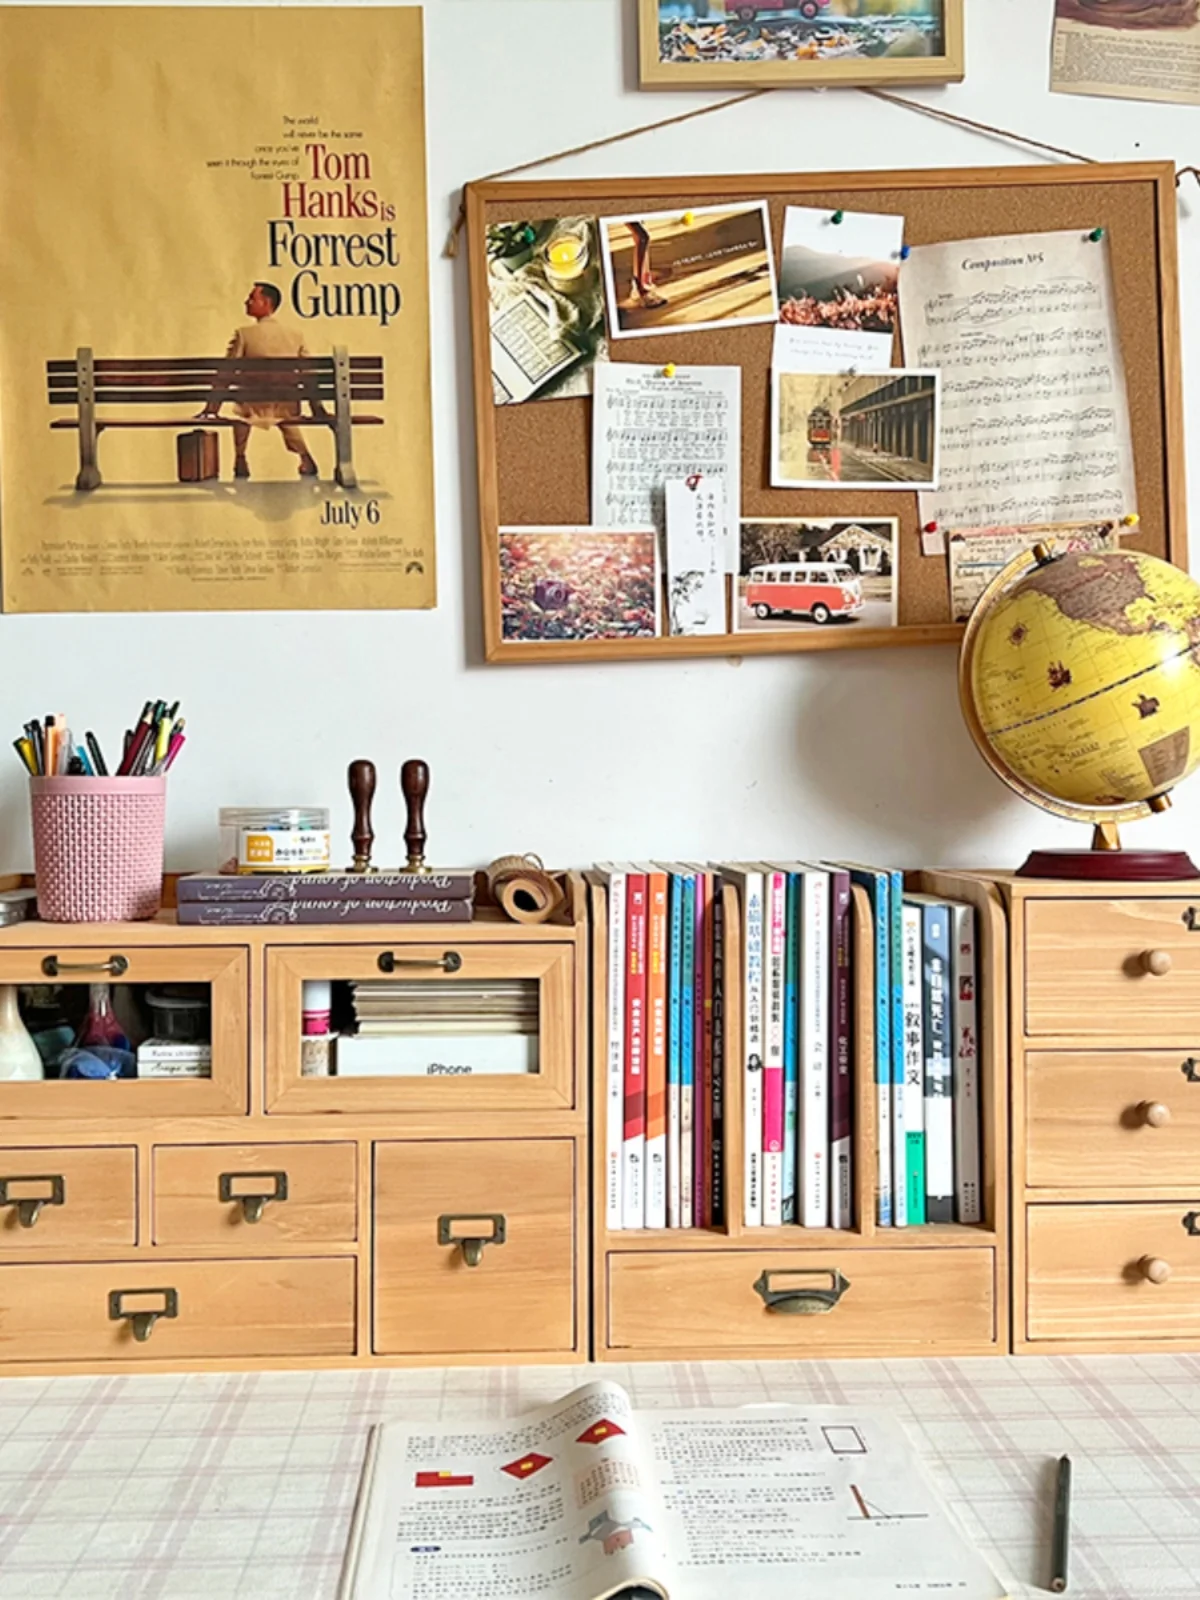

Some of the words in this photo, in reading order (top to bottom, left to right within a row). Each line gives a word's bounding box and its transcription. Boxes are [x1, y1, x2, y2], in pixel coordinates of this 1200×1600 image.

[283, 116, 296, 125] The
[299, 116, 318, 125] world
[283, 131, 295, 139] will
[298, 131, 316, 139] never
[319, 130, 329, 139] be
[331, 130, 342, 139] the
[344, 131, 363, 139] same
[254, 145, 273, 153] once
[231, 158, 257, 170] through
[259, 158, 270, 167] the
[272, 160, 290, 169] eyes
[291, 158, 299, 167] of
[305, 143, 371, 180] Tom
[282, 182, 378, 218] Hanks
[380, 201, 396, 222] is
[267, 220, 400, 268] Forrest
[291, 270, 401, 326] Gump
[320, 500, 362, 529] July
[366, 500, 381, 524] 6
[338, 876, 362, 892] of
[338, 899, 362, 914] of
[905, 1012, 921, 1086] 叙事作文
[427, 1063, 472, 1075] iPhone
